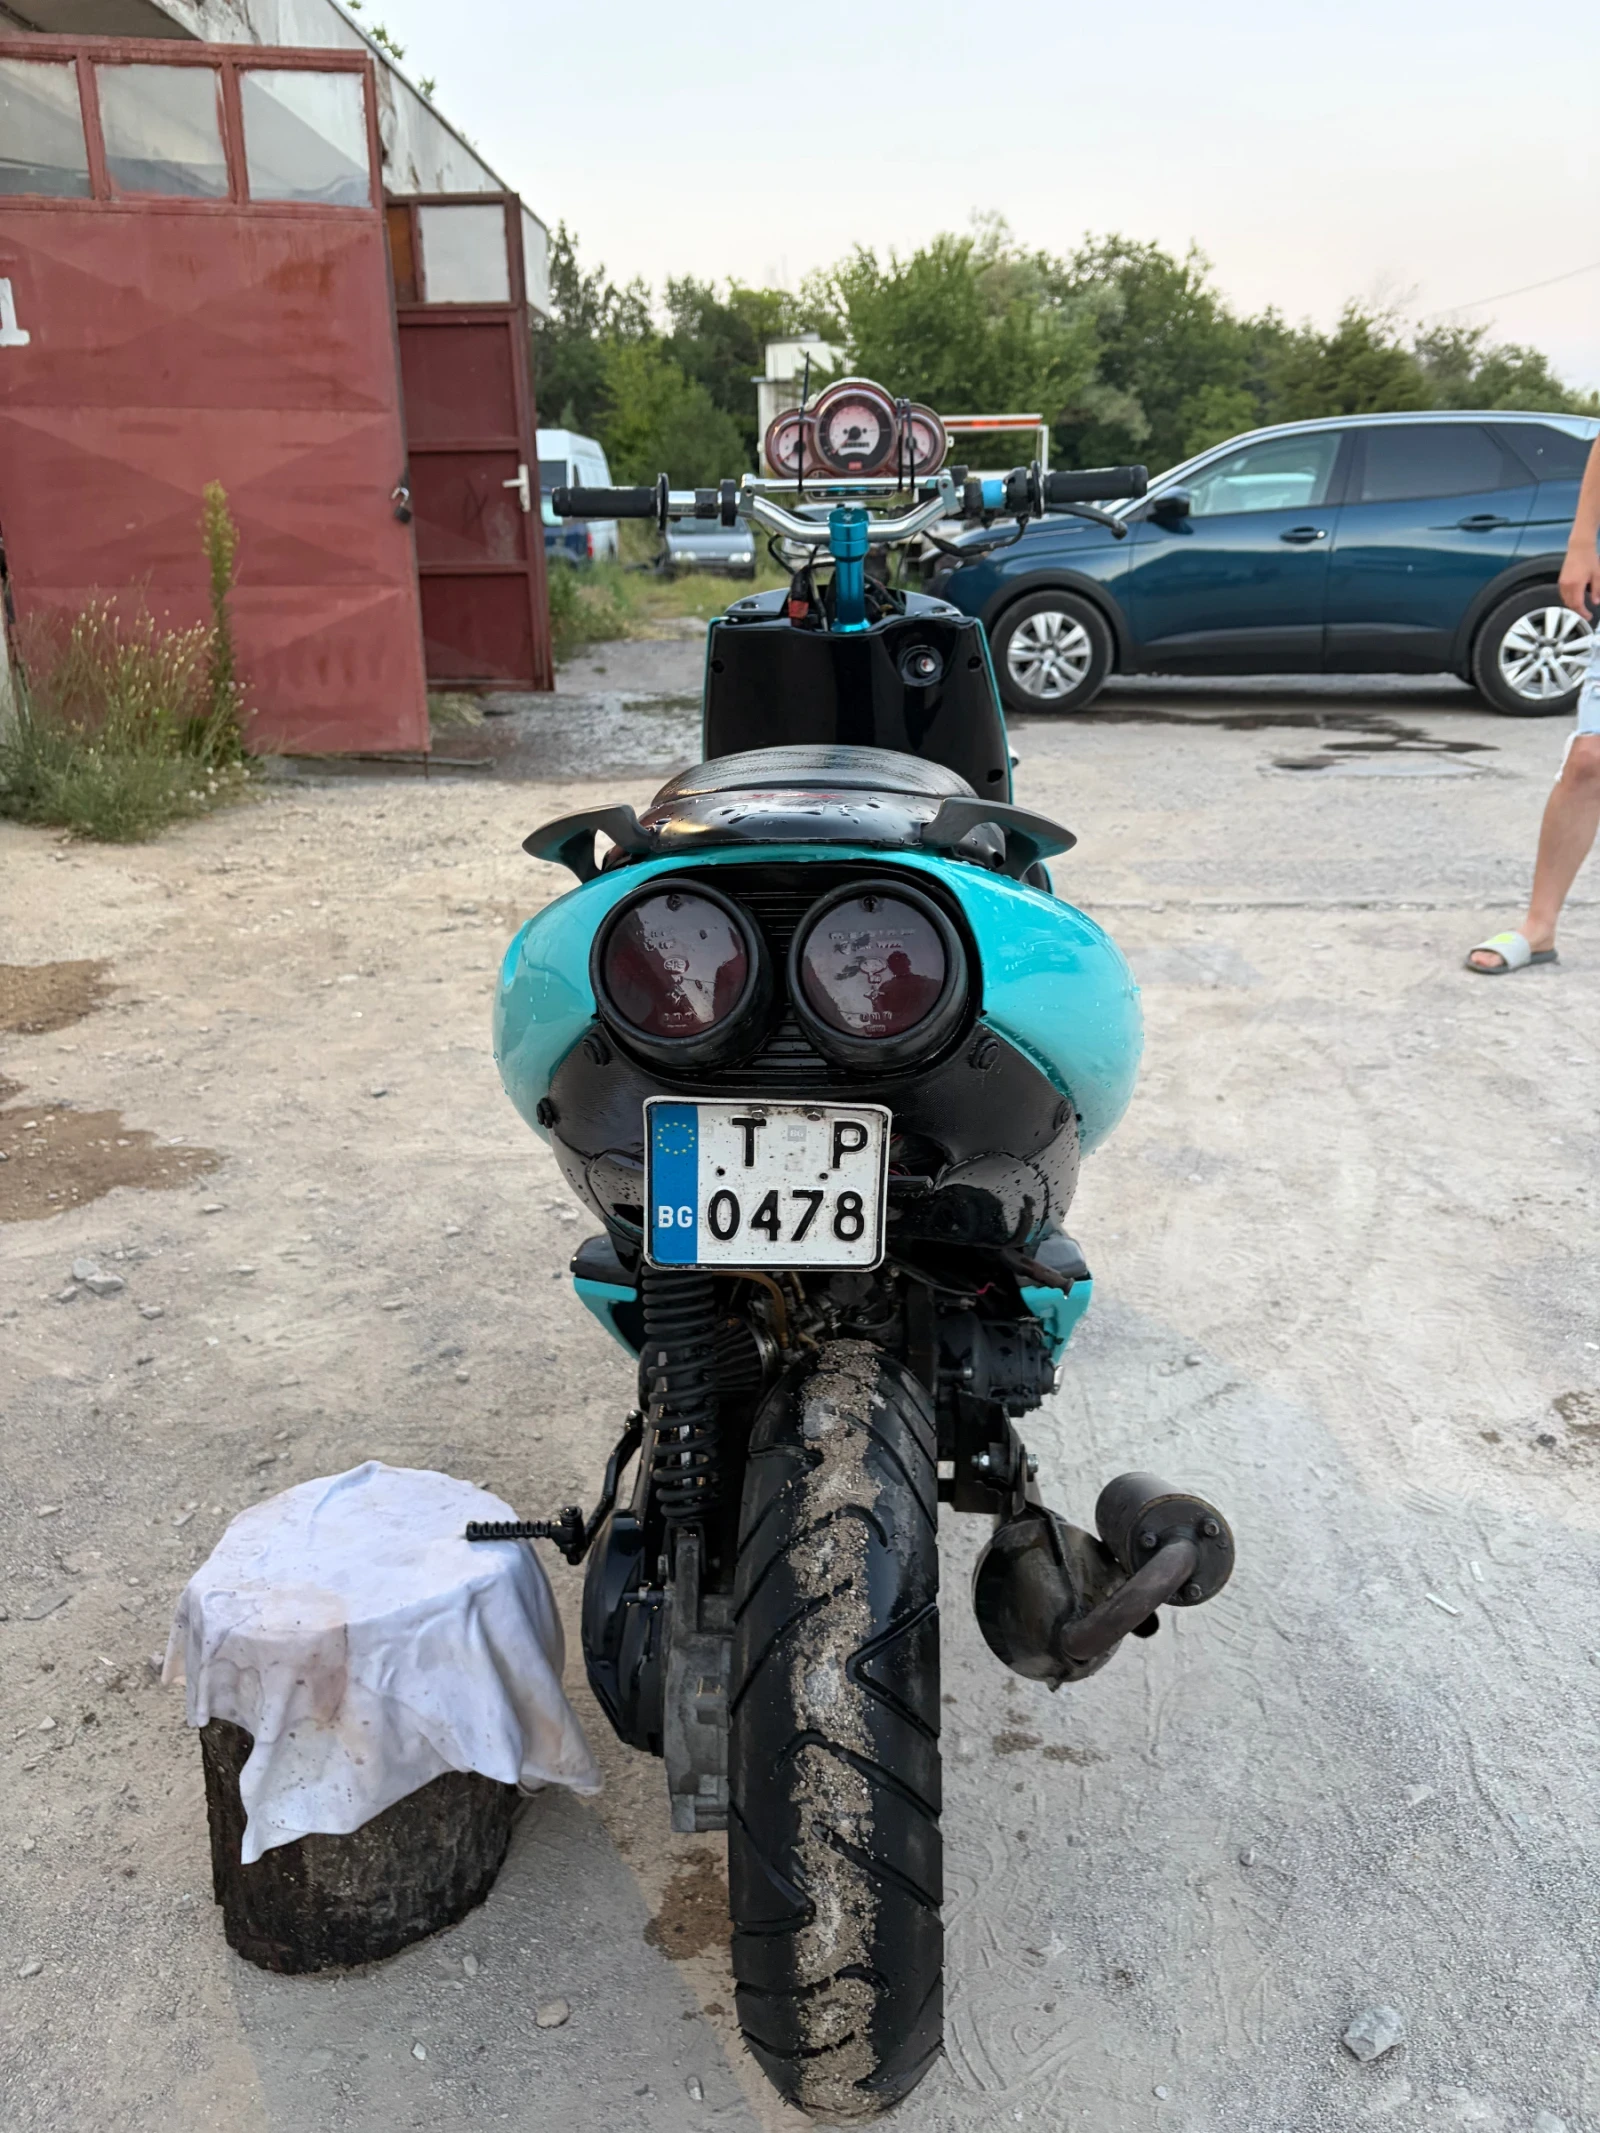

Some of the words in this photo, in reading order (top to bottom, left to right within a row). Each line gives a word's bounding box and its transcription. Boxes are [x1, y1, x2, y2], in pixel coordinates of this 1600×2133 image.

[731, 1117, 767, 1167] T
[832, 1121, 868, 1169] P
[657, 1205, 693, 1228] BG
[707, 1189, 865, 1242] 0478
